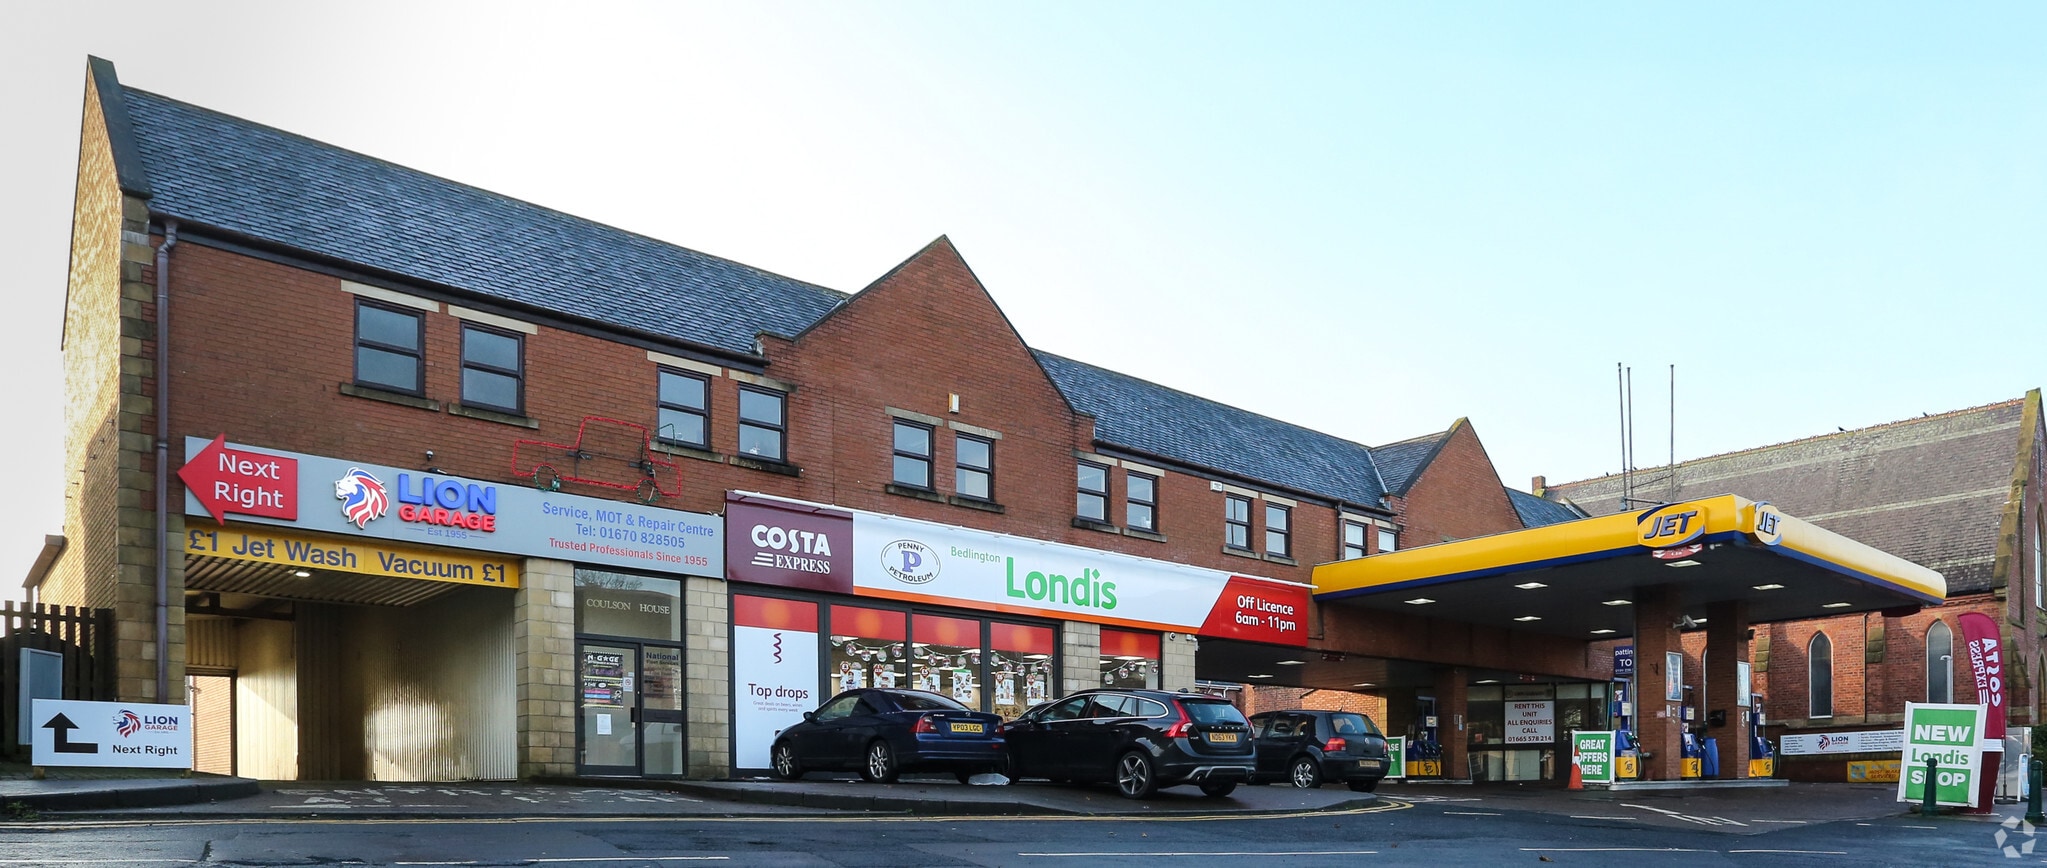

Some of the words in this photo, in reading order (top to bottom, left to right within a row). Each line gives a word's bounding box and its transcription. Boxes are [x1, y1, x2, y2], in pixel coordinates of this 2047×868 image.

[219, 453, 280, 480] Next
[214, 481, 283, 509] Right
[398, 473, 496, 514] LION
[398, 505, 496, 533] GARAGE
[542, 501, 592, 522] Service,
[596, 509, 622, 525] MOT
[625, 516, 635, 526] &
[638, 516, 676, 534] Repair
[678, 521, 714, 538] Centre
[1643, 510, 1699, 540] JET
[1757, 511, 1781, 536] JET
[427, 527, 443, 538] Est
[445, 528, 467, 540] 1955
[575, 523, 597, 538] Tel:
[600, 526, 637, 543] 01670
[640, 532, 686, 549] 828505
[751, 524, 832, 558] COSTA
[188, 529, 218, 552] £1
[232, 534, 275, 561] Jet
[284, 539, 357, 569] Wash
[378, 551, 474, 580] Vacuum
[482, 562, 506, 583] £1
[549, 537, 587, 552] Trusted
[589, 543, 654, 561] Professionals
[656, 552, 681, 564] Since
[684, 555, 708, 567] 1955
[897, 542, 925, 553] PENNY
[951, 546, 1001, 564] Bedlington
[775, 554, 831, 575] EXPRESS
[901, 550, 922, 573] P
[888, 565, 934, 583] PETROLEUM
[1006, 556, 1117, 610] Londis
[586, 598, 631, 611] COULSON
[639, 603, 671, 615] HOUSE
[1237, 595, 1255, 609] Off
[1257, 598, 1294, 615] Licence
[1235, 611, 1259, 626] 6am
[1267, 615, 1296, 633] 11pm
[646, 652, 680, 661] National
[1615, 648, 1634, 657] pattin
[1619, 658, 1633, 667] TO
[748, 683, 772, 700] Top
[775, 685, 809, 701] drops
[144, 715, 179, 725] LION
[1914, 724, 1971, 743] NEW
[112, 745, 142, 755] Next
[145, 745, 178, 757] Right
[1580, 739, 1606, 750] GREAT
[1578, 752, 1608, 763] OFFERS
[1911, 748, 1969, 765] Londis
[1581, 764, 1602, 776] HERE
[1910, 770, 1966, 787] SOP
